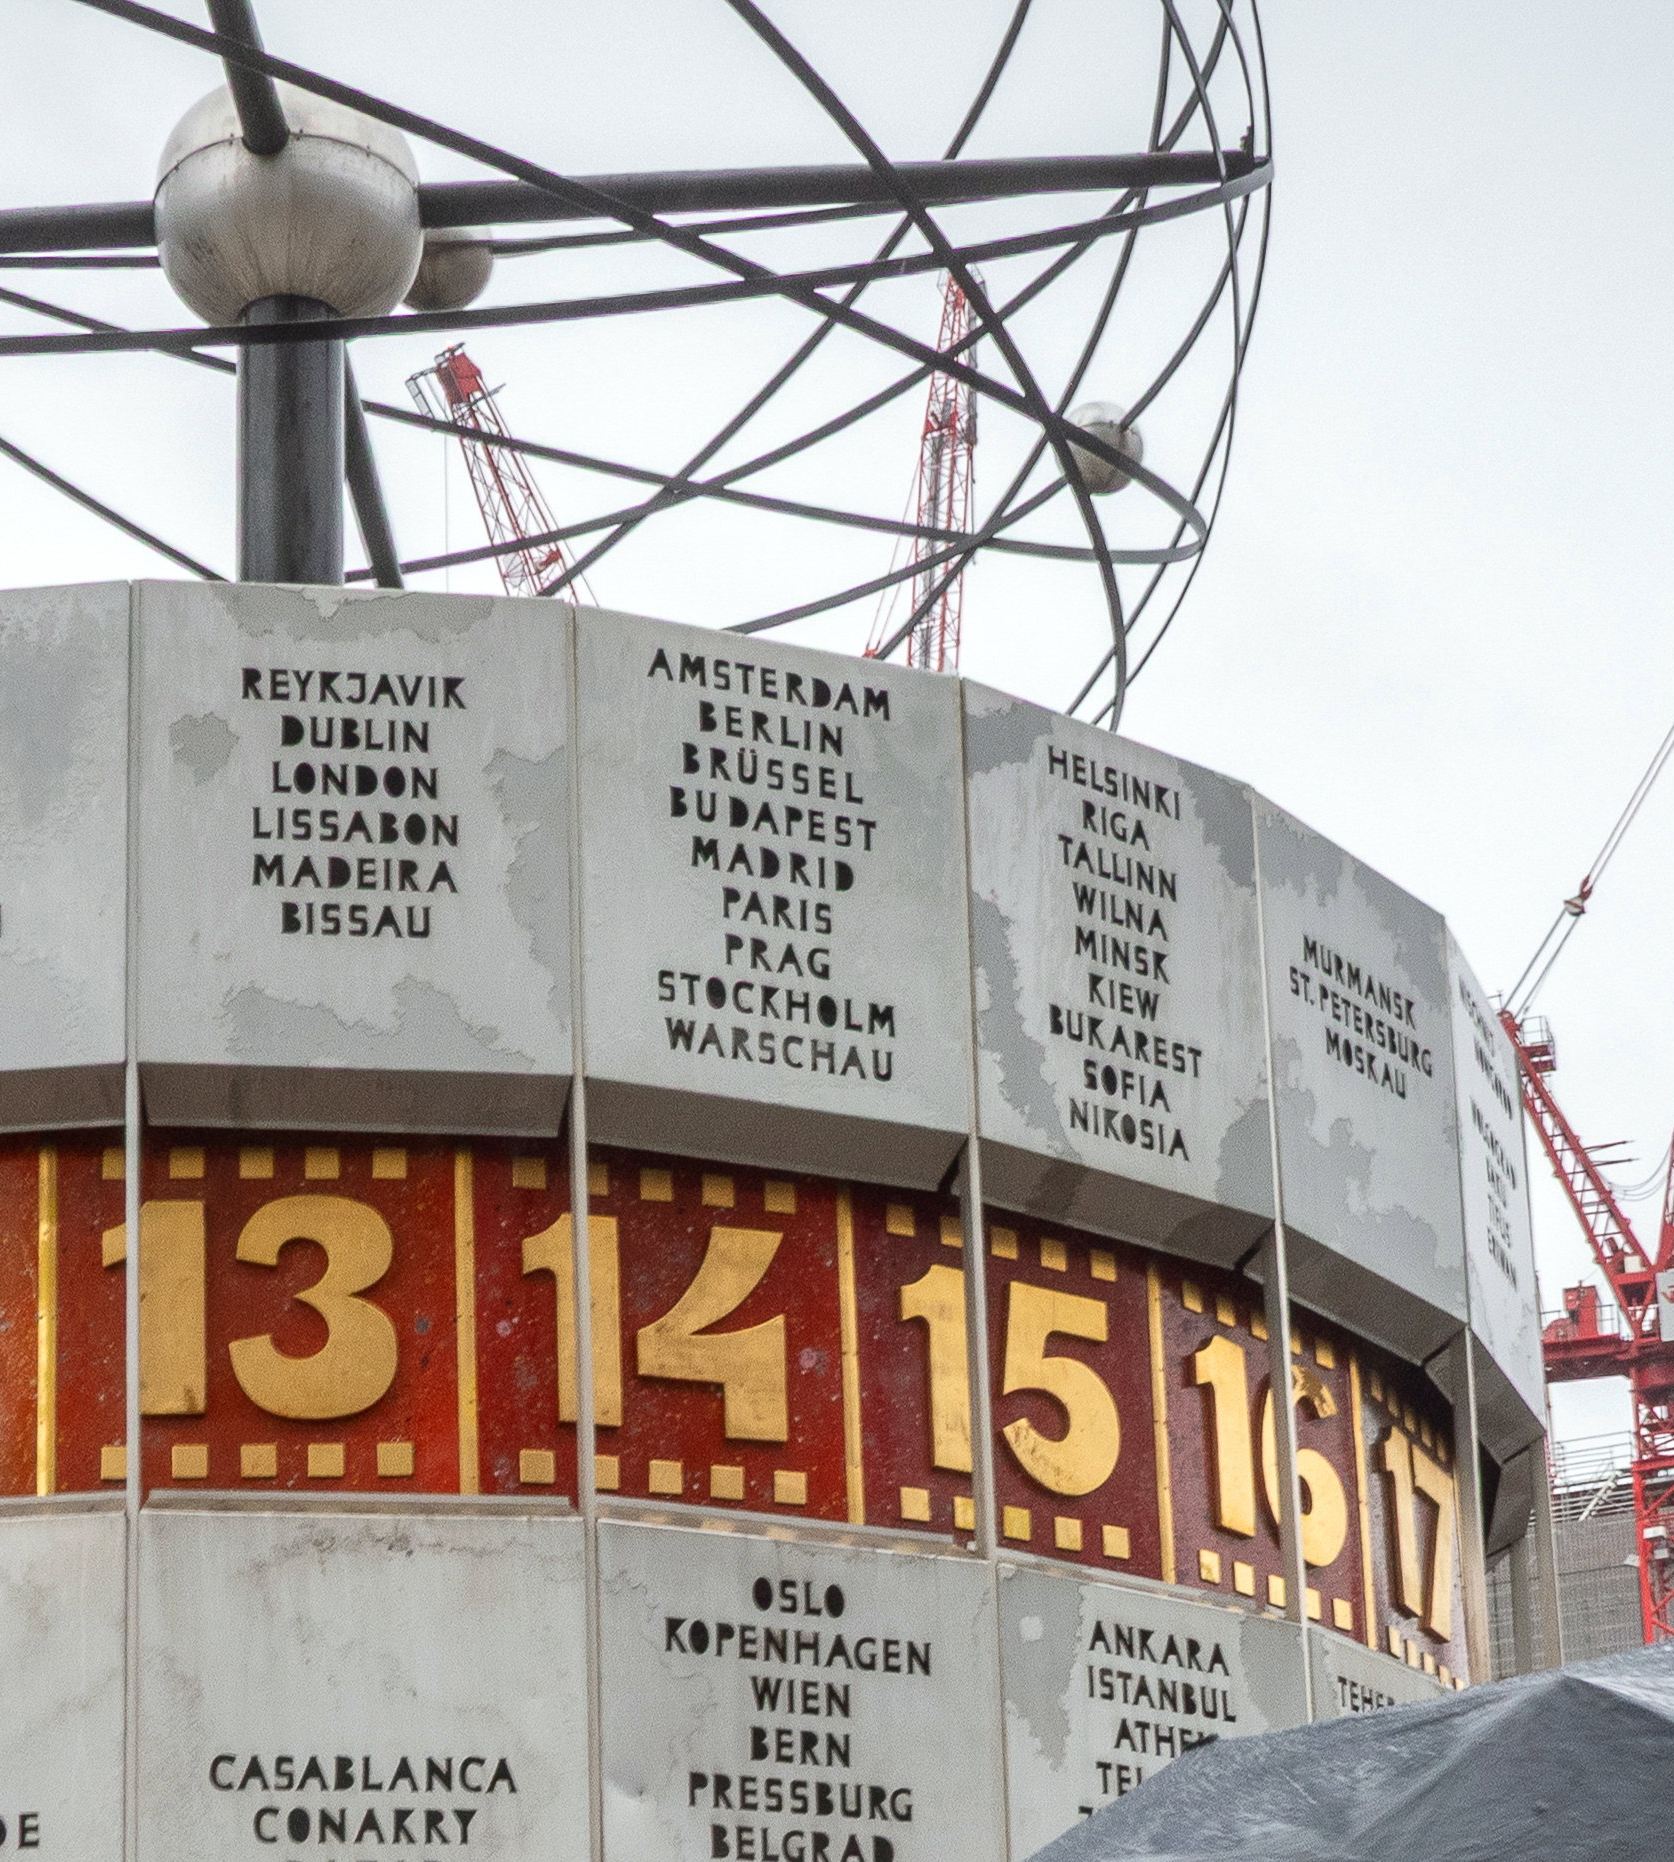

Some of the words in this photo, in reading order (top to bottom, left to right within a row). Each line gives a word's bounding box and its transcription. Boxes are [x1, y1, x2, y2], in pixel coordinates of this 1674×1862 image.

[242, 668, 466, 709] REYKJAVIK
[648, 648, 889, 720] AMSTERDAM
[281, 715, 429, 753] DUBLIN
[699, 700, 843, 757] BERLIN
[272, 761, 438, 799] LONDON
[683, 742, 863, 803] BRÜSSEL
[1048, 745, 1180, 821] HELSINKI
[253, 807, 458, 846] LISSABON
[670, 786, 876, 851] BUDAPEST
[1082, 800, 1150, 851] RIGA
[252, 854, 458, 892] MADEIRA
[691, 836, 854, 891] MADRID
[1058, 834, 1177, 902] TALLINN
[281, 902, 431, 938] BISSAU
[723, 887, 832, 934] PARIS
[1073, 881, 1168, 941] WILNA
[725, 933, 830, 980] PRAG
[1075, 925, 1170, 985] MINSK
[1303, 934, 1416, 1031] MURMANSK
[658, 970, 895, 1037] STOCKHOLM
[1088, 972, 1160, 1021] KIEW
[1290, 966, 1314, 1006] ST.
[1318, 983, 1433, 1078] PETERSBURG
[666, 1017, 893, 1082] WARSCHAU
[1049, 1004, 1202, 1078] BUKAREST
[1326, 1026, 1406, 1099] MOSKAU
[1083, 1059, 1171, 1113] SOFIA
[1070, 1098, 1189, 1161] NIKOSIA
[103, 1195, 398, 1420] 13
[523, 1213, 787, 1442] 14
[901, 1263, 1120, 1496] 15
[1196, 1335, 1348, 1567] 16
[1384, 1425, 1454, 1642] 17
[752, 1577, 845, 1618] OSLO
[665, 1616, 931, 1676] KOPENHAGEN
[1088, 1620, 1230, 1676] ANKARA
[751, 1676, 850, 1718] WIEN
[1087, 1665, 1236, 1722] ISTANBUL
[750, 1727, 850, 1767] BERN
[1114, 1718, 1210, 1757] ATHE
[209, 1754, 517, 1794] CASABLANCA
[689, 1771, 912, 1822] PRESSBURG
[254, 1806, 477, 1844] CONAKRY
